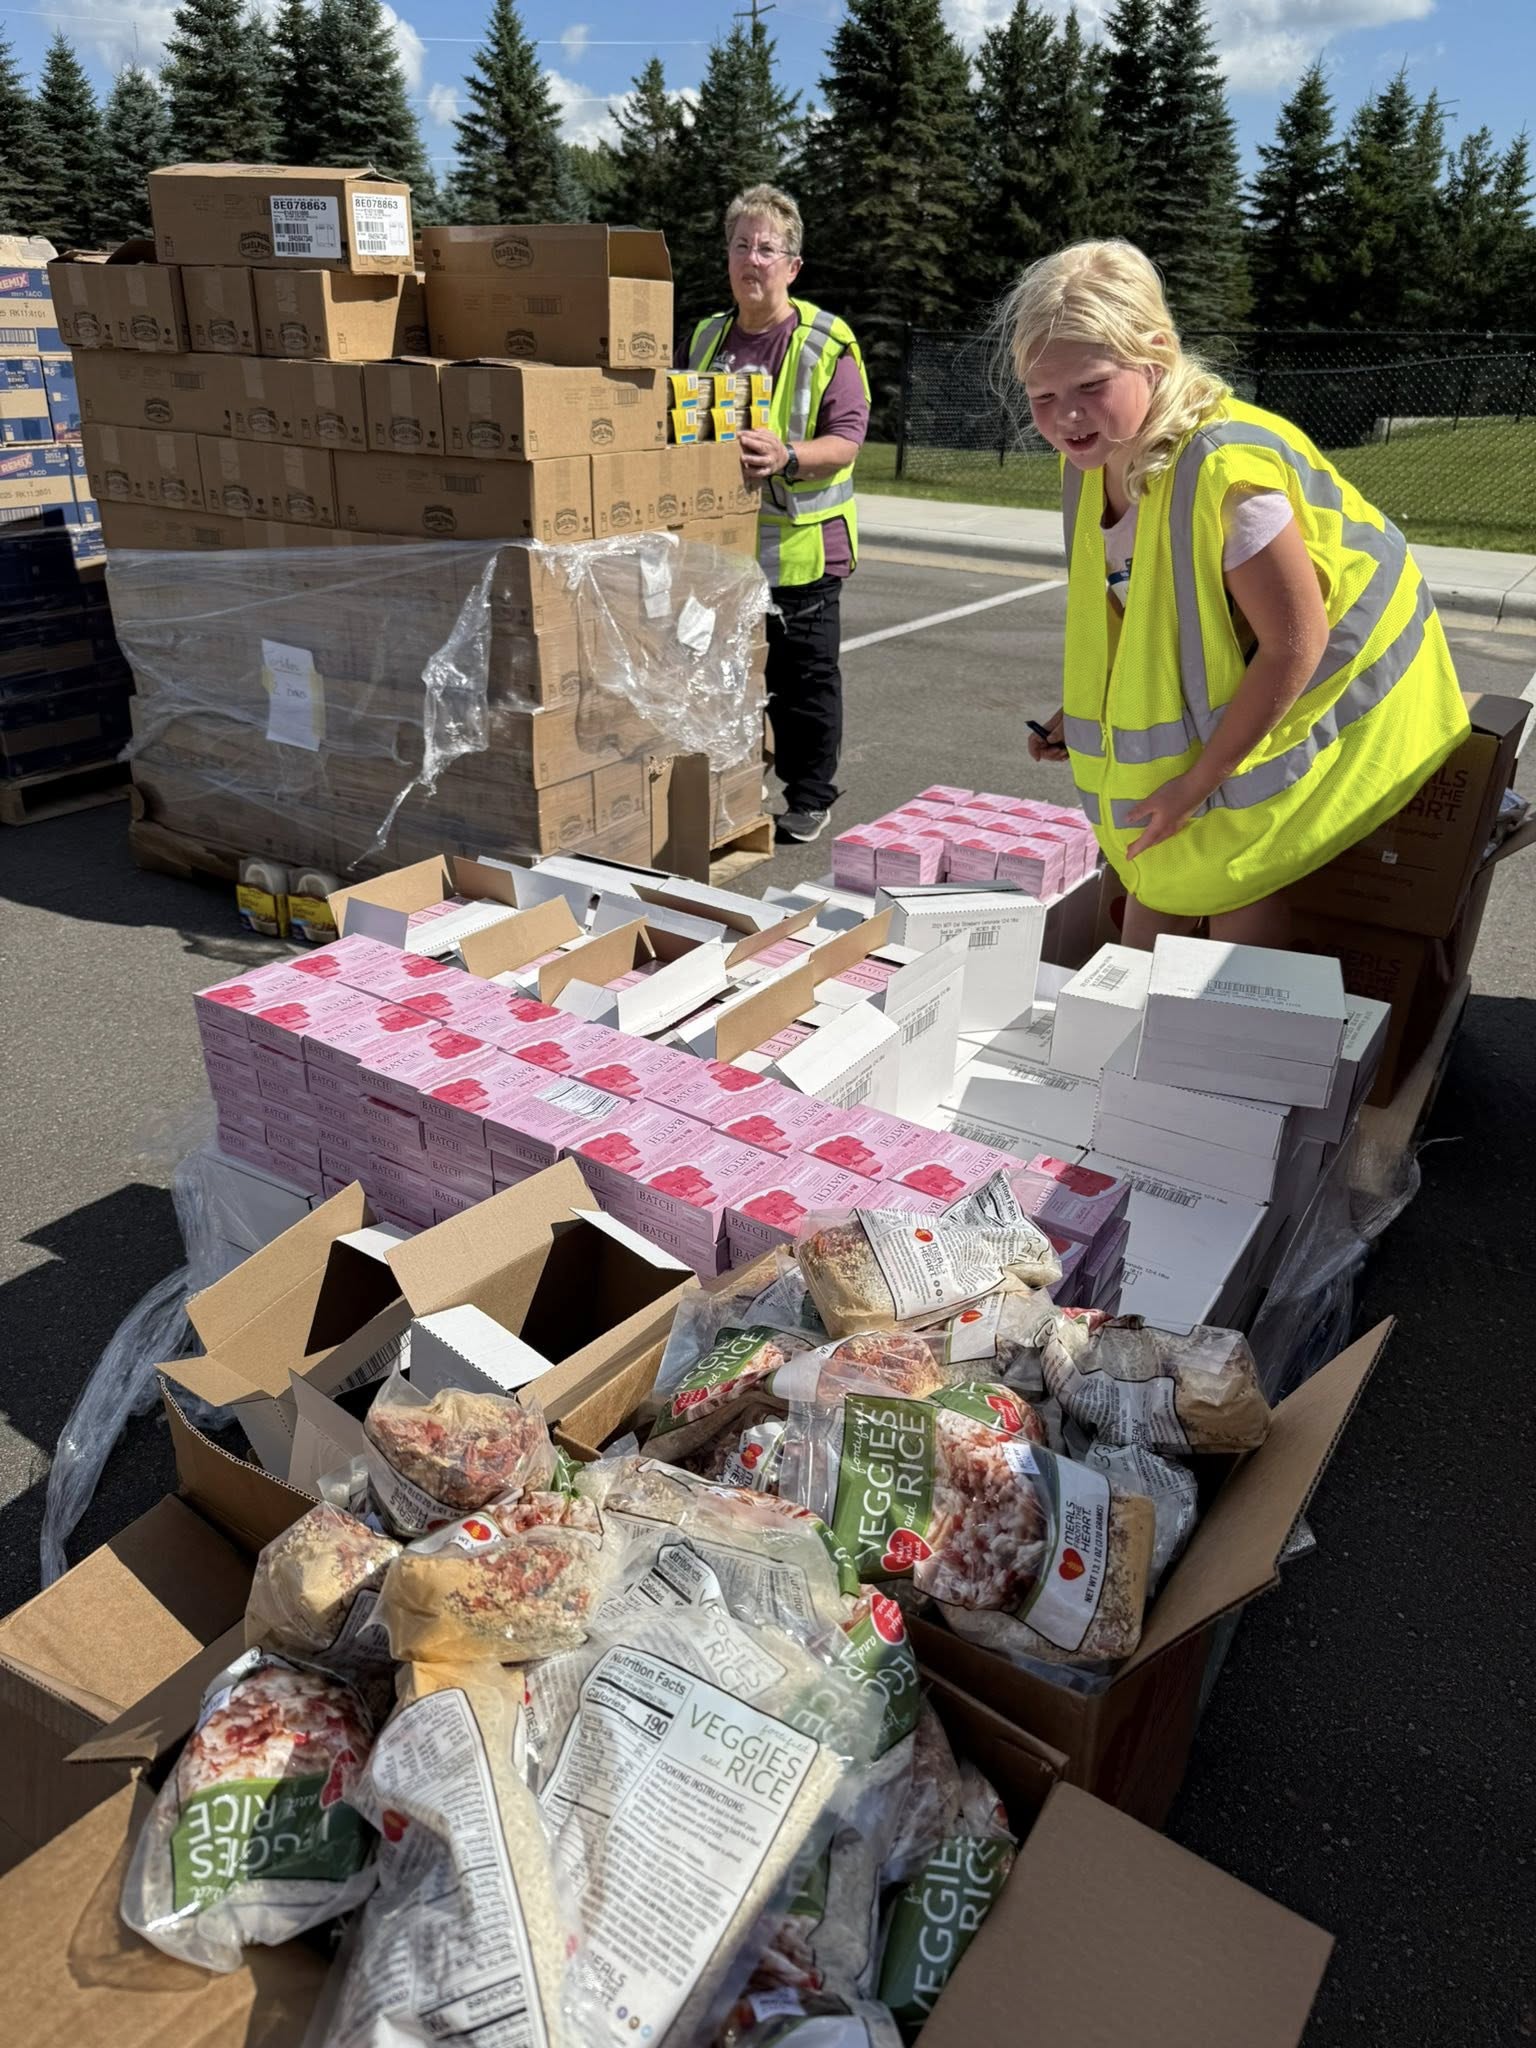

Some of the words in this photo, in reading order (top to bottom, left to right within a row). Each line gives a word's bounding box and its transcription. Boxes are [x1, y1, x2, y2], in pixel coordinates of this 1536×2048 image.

[273, 201, 327, 211] 8E078863
[355, 199, 399, 210] 8E078863
[1, 455, 33, 473] REMIX
[28, 469, 48, 477] TACO
[268, 974, 305, 992] BATCH
[358, 971, 392, 986] BATCH
[843, 973, 883, 988] BATCH
[859, 965, 887, 979] BATC
[321, 993, 361, 1012] BATCH
[464, 984, 496, 1001] BATCH
[327, 1022, 367, 1043] BATCH
[467, 1016, 501, 1033] BATCH
[578, 1029, 610, 1050] BATCH
[382, 1051, 421, 1073] BATCH
[647, 1052, 680, 1074] BATCH
[263, 1079, 289, 1095] BATCH
[311, 1073, 337, 1090] BATCH
[361, 1073, 391, 1090] BATCH
[499, 1066, 535, 1088] BATCH
[670, 1083, 704, 1104] BATCH
[264, 1106, 290, 1121] BATCH
[319, 1103, 345, 1120] BATCH
[363, 1106, 390, 1124] BATCH
[422, 1101, 451, 1119] BATCH
[792, 1102, 824, 1127] BATCH
[320, 1131, 347, 1148] BATCH
[429, 1132, 459, 1151] BATCH
[649, 1118, 685, 1145] BATCH
[882, 1124, 910, 1147] BATCH
[371, 1135, 399, 1153] BATCH
[372, 1160, 401, 1180] BATCH
[432, 1160, 461, 1179] BATCH
[577, 1158, 603, 1178] ATCH
[720, 1150, 757, 1177] BATCH
[969, 1152, 1000, 1176] BATCH
[813, 1173, 849, 1202] BATCH
[435, 1189, 464, 1209] BATCH
[639, 1190, 675, 1212] BATCH
[1006, 1200, 1018, 1222] Facts
[642, 1223, 679, 1245] BATCH
[731, 1217, 769, 1240] BATCH
[932, 1243, 946, 1275] MEALS
[716, 1333, 764, 1372] RICE
[895, 1415, 925, 1497] RICE
[855, 1409, 898, 1562] VEGGIES
[905, 1501, 917, 1529] and
[1065, 1500, 1076, 1546] MEALS
[1075, 1504, 1084, 1521] THE
[1074, 1520, 1083, 1550] FROM
[1081, 1509, 1093, 1554] HEART.
[669, 1550, 693, 1574] utrition
[1093, 1546, 1101, 1558] OZ
[641, 1578, 665, 1602] Calories
[1087, 1577, 1097, 1590] WT
[1084, 1588, 1093, 1604] NET
[857, 1636, 877, 1665] and
[609, 1651, 656, 1679] Nutrition
[654, 1671, 688, 1695] Facts
[705, 1641, 749, 1701] RICE
[586, 1686, 628, 1711] Calories
[642, 1712, 670, 1736] 190
[690, 1703, 802, 1781] VEGGIES
[655, 1757, 692, 1784] COOKING
[690, 1776, 746, 1815] INSTRUCTIONS:
[701, 1752, 721, 1771] and
[724, 1758, 792, 1805] RICE
[186, 1794, 277, 1844] RICE
[960, 1836, 997, 1931] RICE
[912, 1836, 964, 2013] VEGGIE
[593, 1953, 627, 1988] EALS
[465, 1981, 524, 2012] Calories
